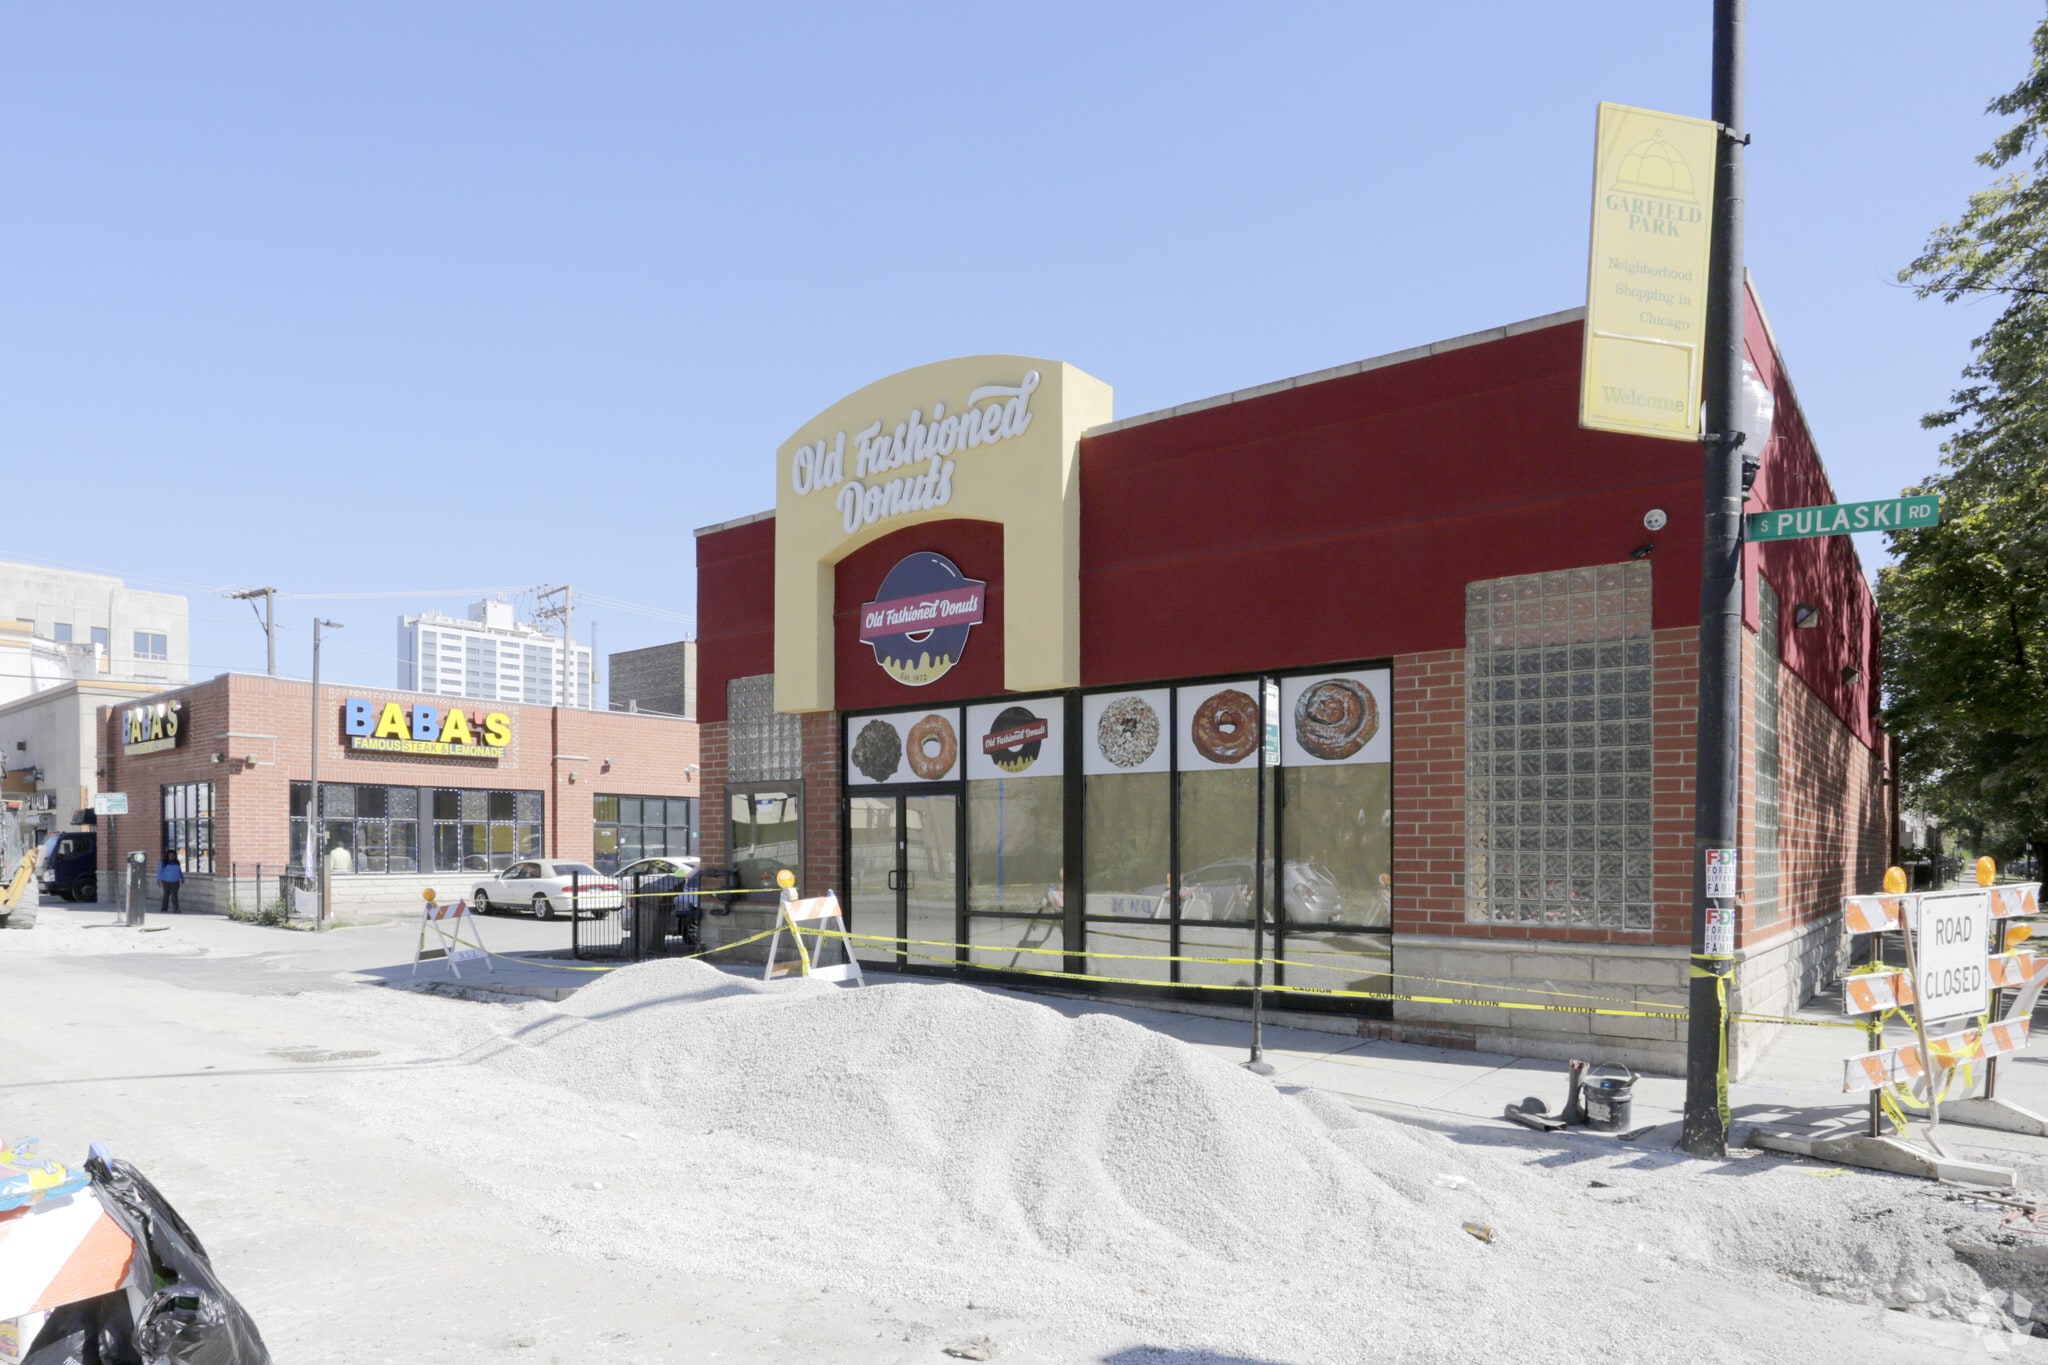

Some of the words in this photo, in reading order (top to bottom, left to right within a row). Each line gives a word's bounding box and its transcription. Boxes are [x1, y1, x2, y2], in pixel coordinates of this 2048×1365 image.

[1605, 194, 1703, 225] GARFIELD
[1629, 214, 1680, 237] PARK
[1607, 257, 1693, 282] Neighborhood
[1615, 283, 1675, 305] Shopping
[1679, 292, 1692, 306] in
[1639, 311, 1690, 331] Chicago
[1602, 385, 1685, 413] Welcome
[792, 431, 847, 496] Old
[854, 370, 1041, 479] Fashioned
[836, 455, 955, 534] Donuts
[1760, 520, 1769, 532] S
[1777, 503, 1902, 536] PULASKI
[1909, 504, 1931, 519] RD
[865, 610, 885, 629] Old
[886, 599, 940, 626] Fashioned
[940, 594, 979, 617] Donuts
[346, 698, 512, 747] BABA'S
[985, 738, 996, 748] Old
[996, 730, 1025, 745] Fashioned
[1025, 725, 1046, 738] Donuts
[353, 737, 401, 752] FAMOUS
[402, 740, 439, 754] STEAK
[440, 742, 449, 754] &
[450, 743, 505, 758] LEMONADE
[1936, 916, 1972, 946] ROAD
[1926, 966, 1981, 1000] CLOSED
[1452, 998, 1499, 1008] CAUTION
[1645, 1011, 1689, 1020] CAUTIO
